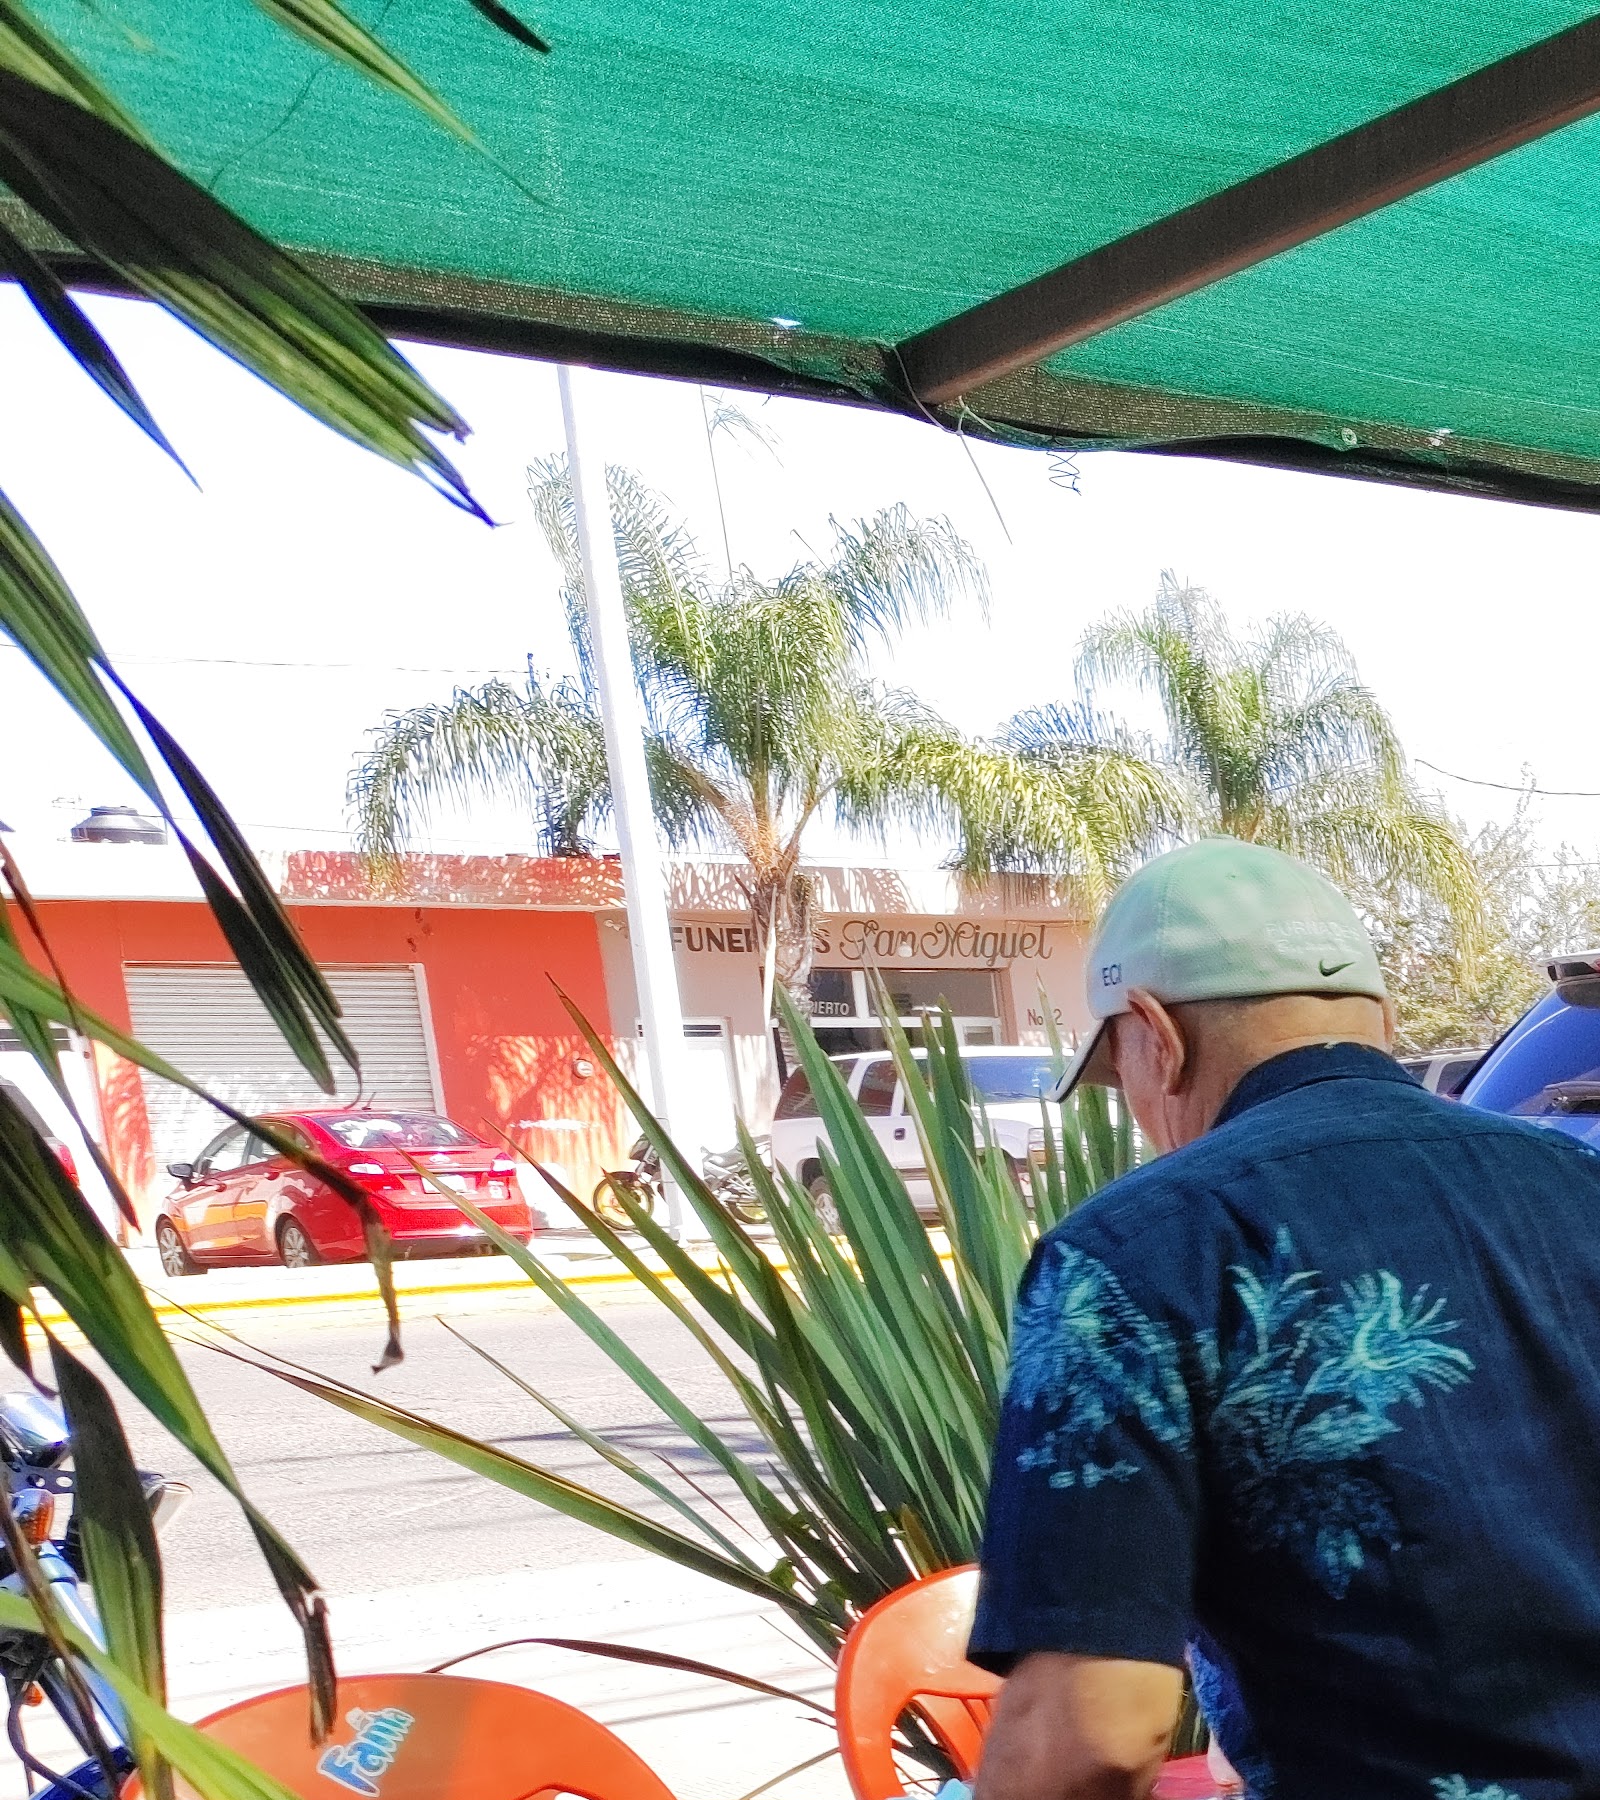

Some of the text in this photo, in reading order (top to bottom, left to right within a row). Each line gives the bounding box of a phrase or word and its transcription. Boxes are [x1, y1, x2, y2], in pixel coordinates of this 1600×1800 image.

[839, 919, 918, 961] San
[920, 920, 1053, 967] Miguel
[317, 1706, 415, 1798] Fanta
